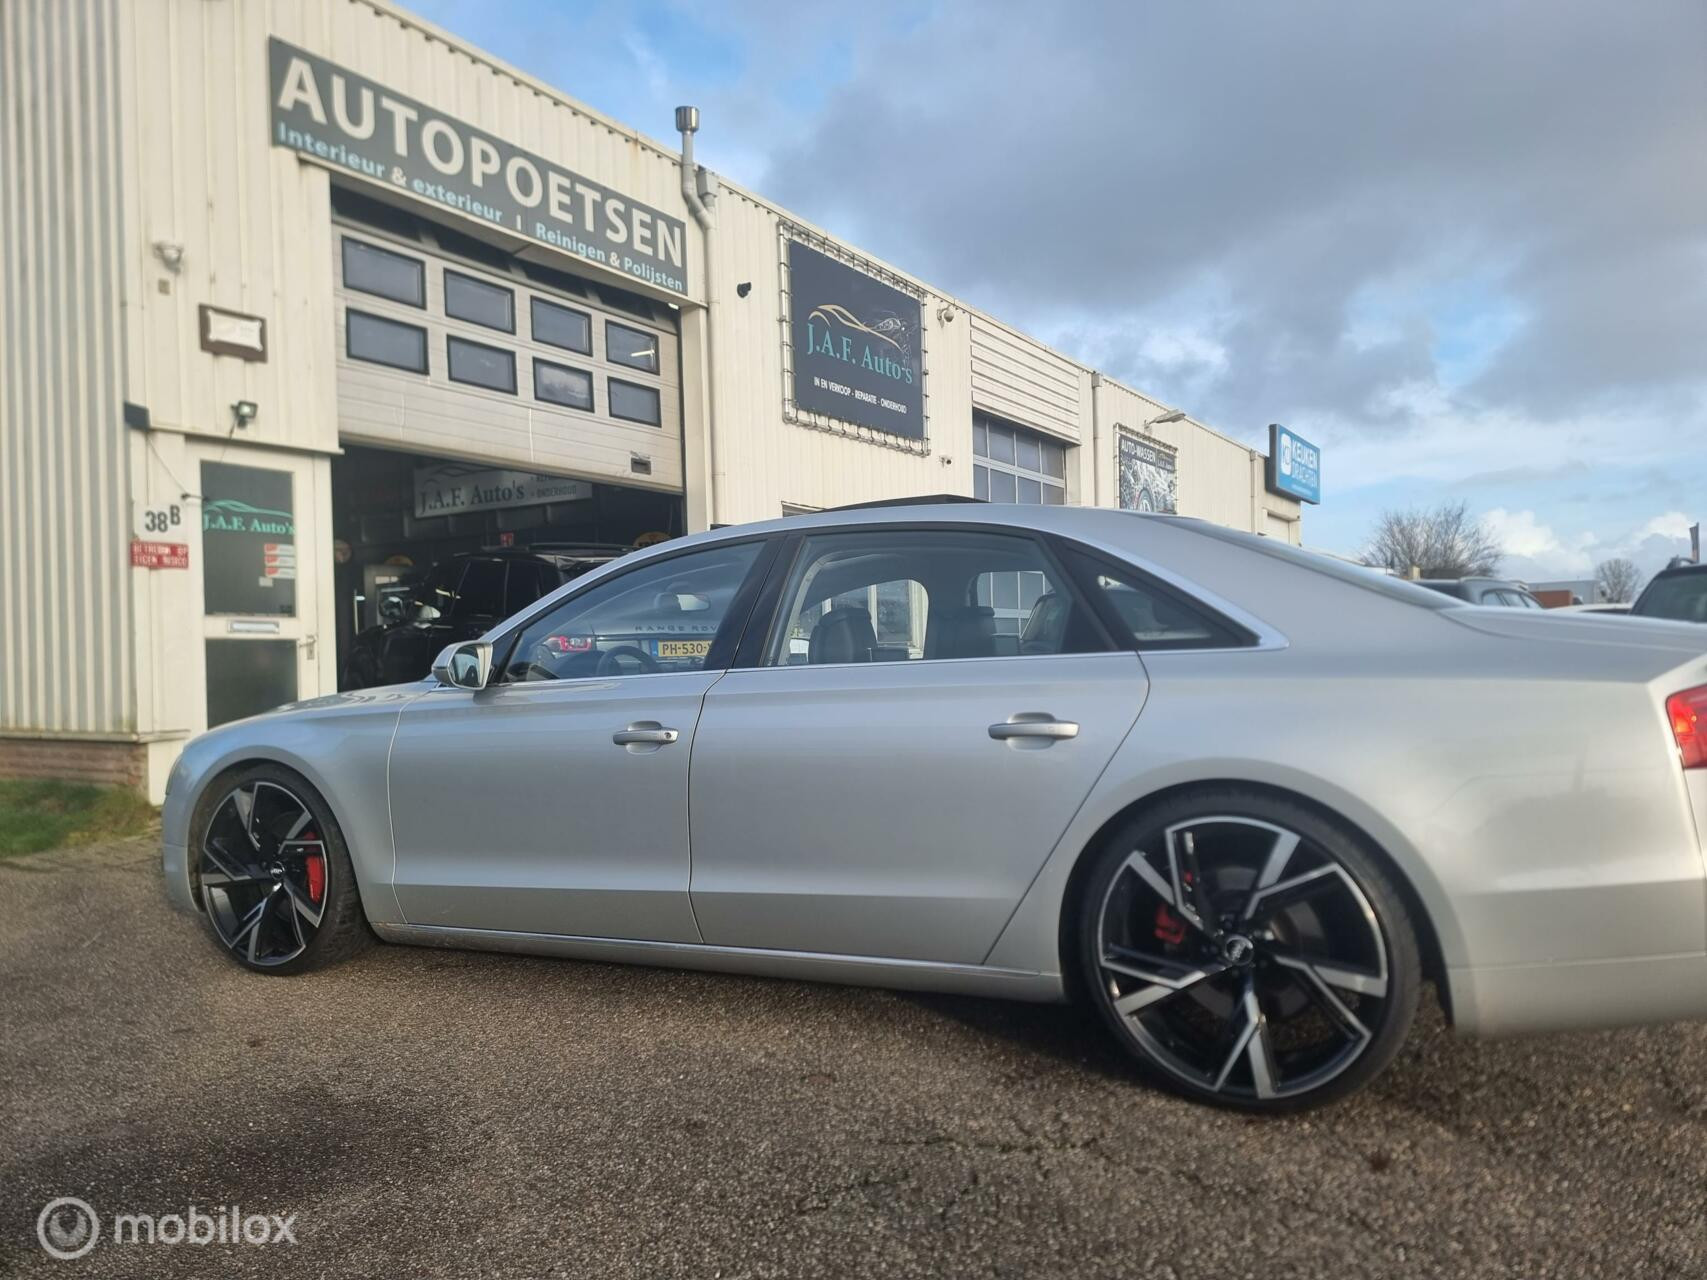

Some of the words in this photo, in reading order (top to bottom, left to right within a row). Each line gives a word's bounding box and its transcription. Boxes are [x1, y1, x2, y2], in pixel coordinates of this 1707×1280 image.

[278, 57, 682, 268] AUTOPOETSEN
[278, 122, 385, 178] Interieur
[391, 167, 407, 188] &
[413, 177, 503, 223] exterieur
[536, 222, 606, 263] Reinigen
[610, 252, 621, 267] &
[624, 257, 683, 291] Polijsten
[808, 323, 856, 365] J.A.F.
[861, 345, 913, 385] Auto's
[814, 376, 820, 387] IN
[821, 378, 828, 389] EN
[829, 381, 851, 396] VERKOOP
[854, 389, 877, 405] REPARATIE
[880, 398, 907, 414] ONDERHOUD
[420, 487, 465, 515] J.A.F.
[470, 480, 526, 509] Auto's
[203, 513, 246, 531] J.A.F.
[635, 624, 685, 632] RANGE
